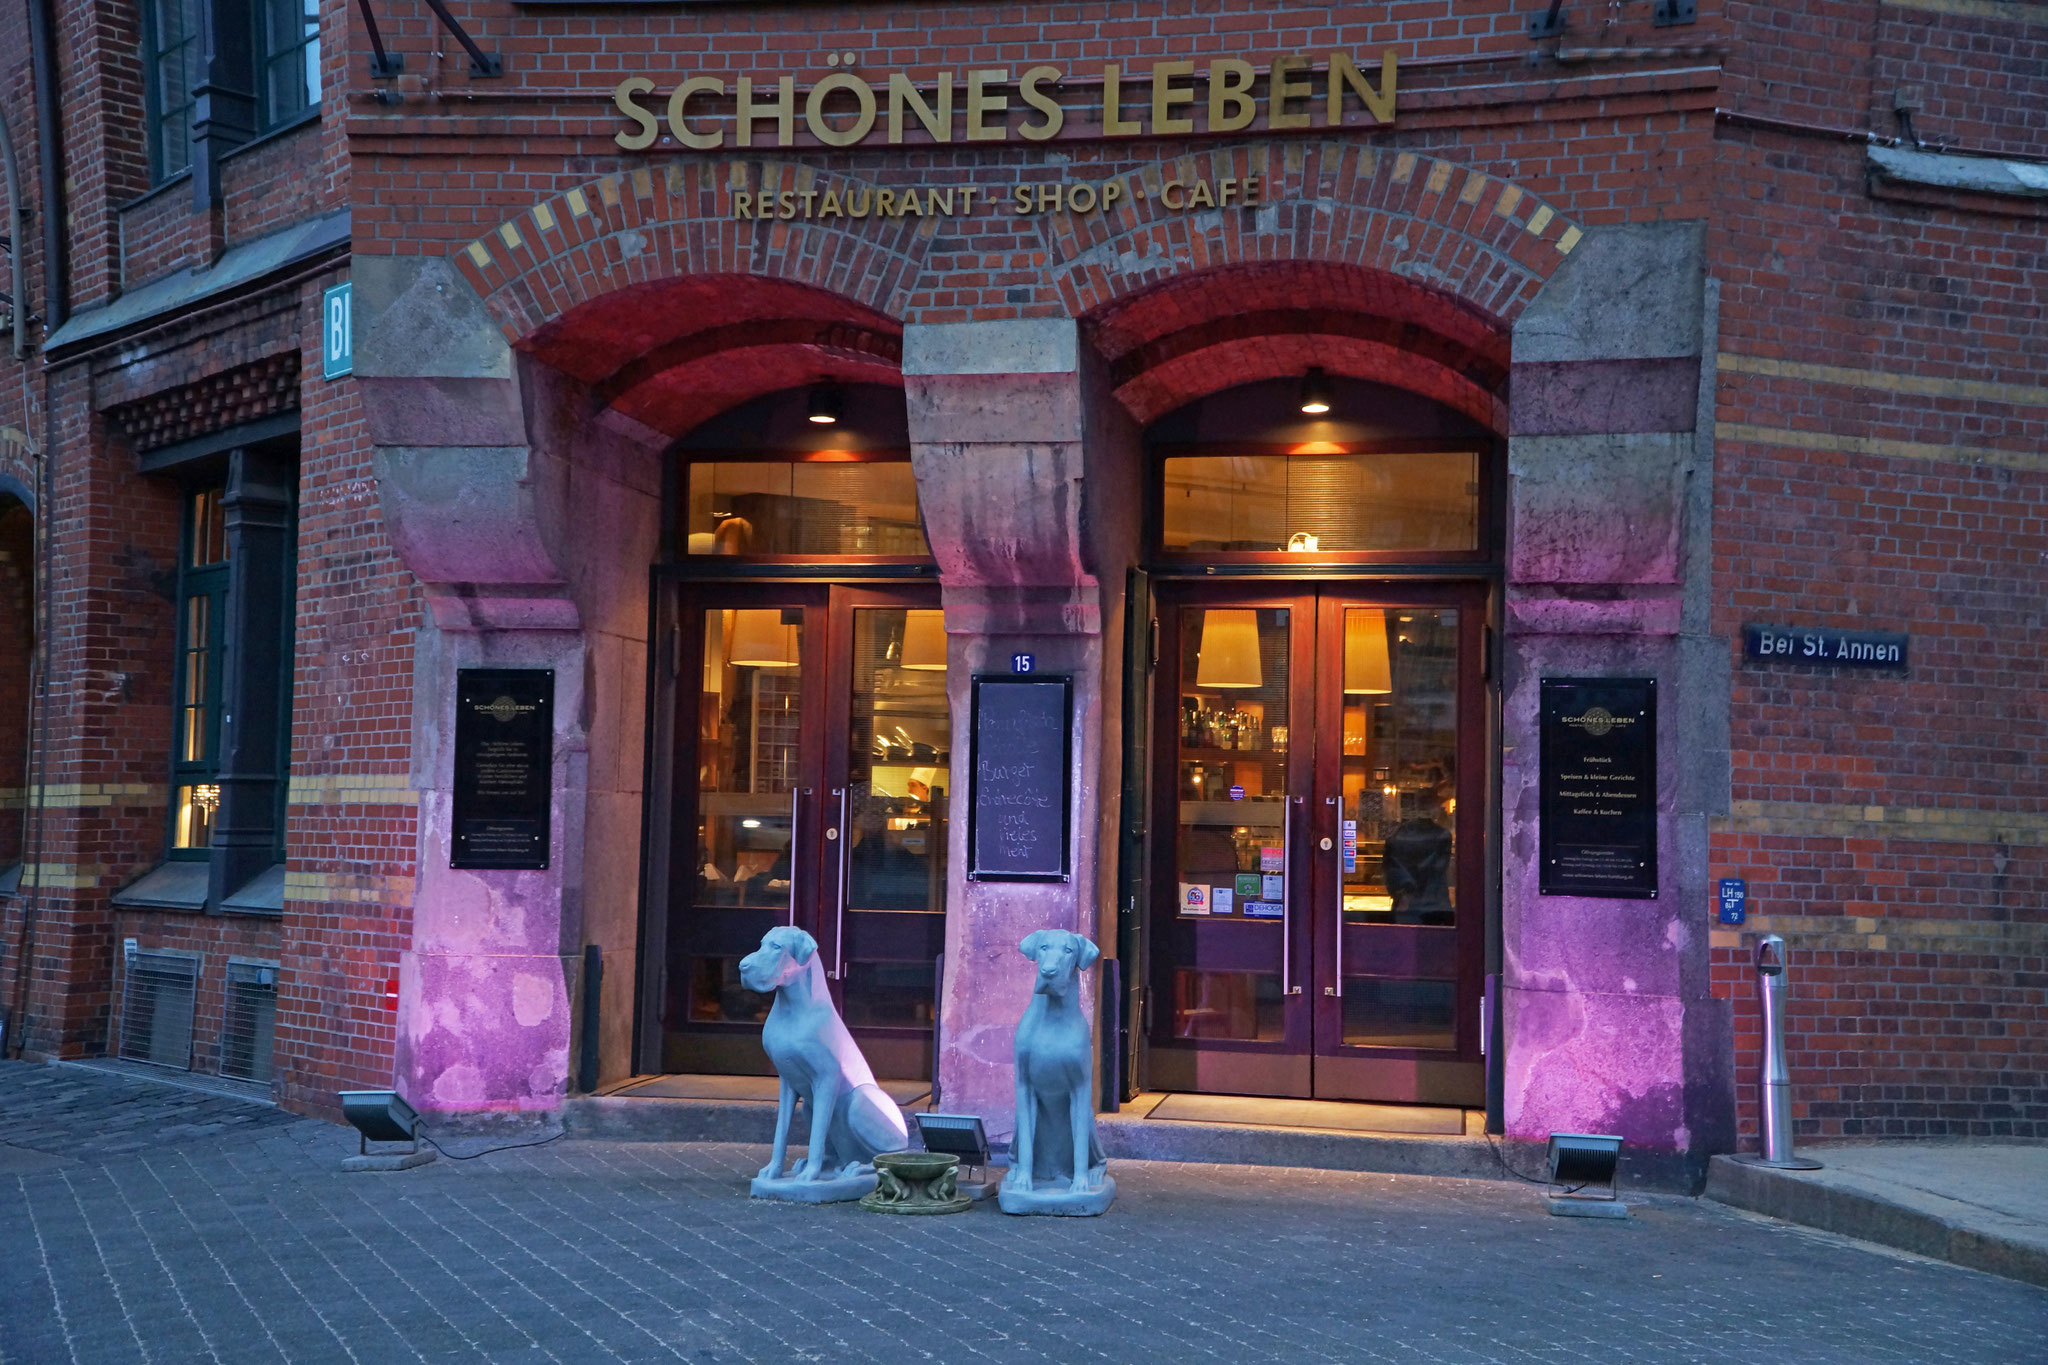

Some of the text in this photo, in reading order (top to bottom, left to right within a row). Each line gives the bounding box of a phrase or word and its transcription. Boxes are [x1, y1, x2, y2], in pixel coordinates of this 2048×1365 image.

[614, 47, 1398, 151] SCHÖNES LEBEN
[733, 185, 978, 221] RESTAURANT
[1014, 178, 1121, 214] SHOP
[1759, 631, 1900, 662] Bei St. Annen
[1014, 655, 1030, 672] 15
[1561, 715, 1635, 724] SCHÖNES LEBEN
[1583, 756, 1612, 764] Frühstück
[1560, 773, 1583, 782] Speisen
[1590, 773, 1608, 781] kleine
[1609, 774, 1636, 782] Gerichte
[1559, 790, 1594, 799] Mittagstisch
[1602, 791, 1637, 799] Abendessen
[1573, 808, 1592, 816] Kaffee
[1600, 809, 1622, 817] Kuchen
[1722, 887, 1744, 899] LH 150
